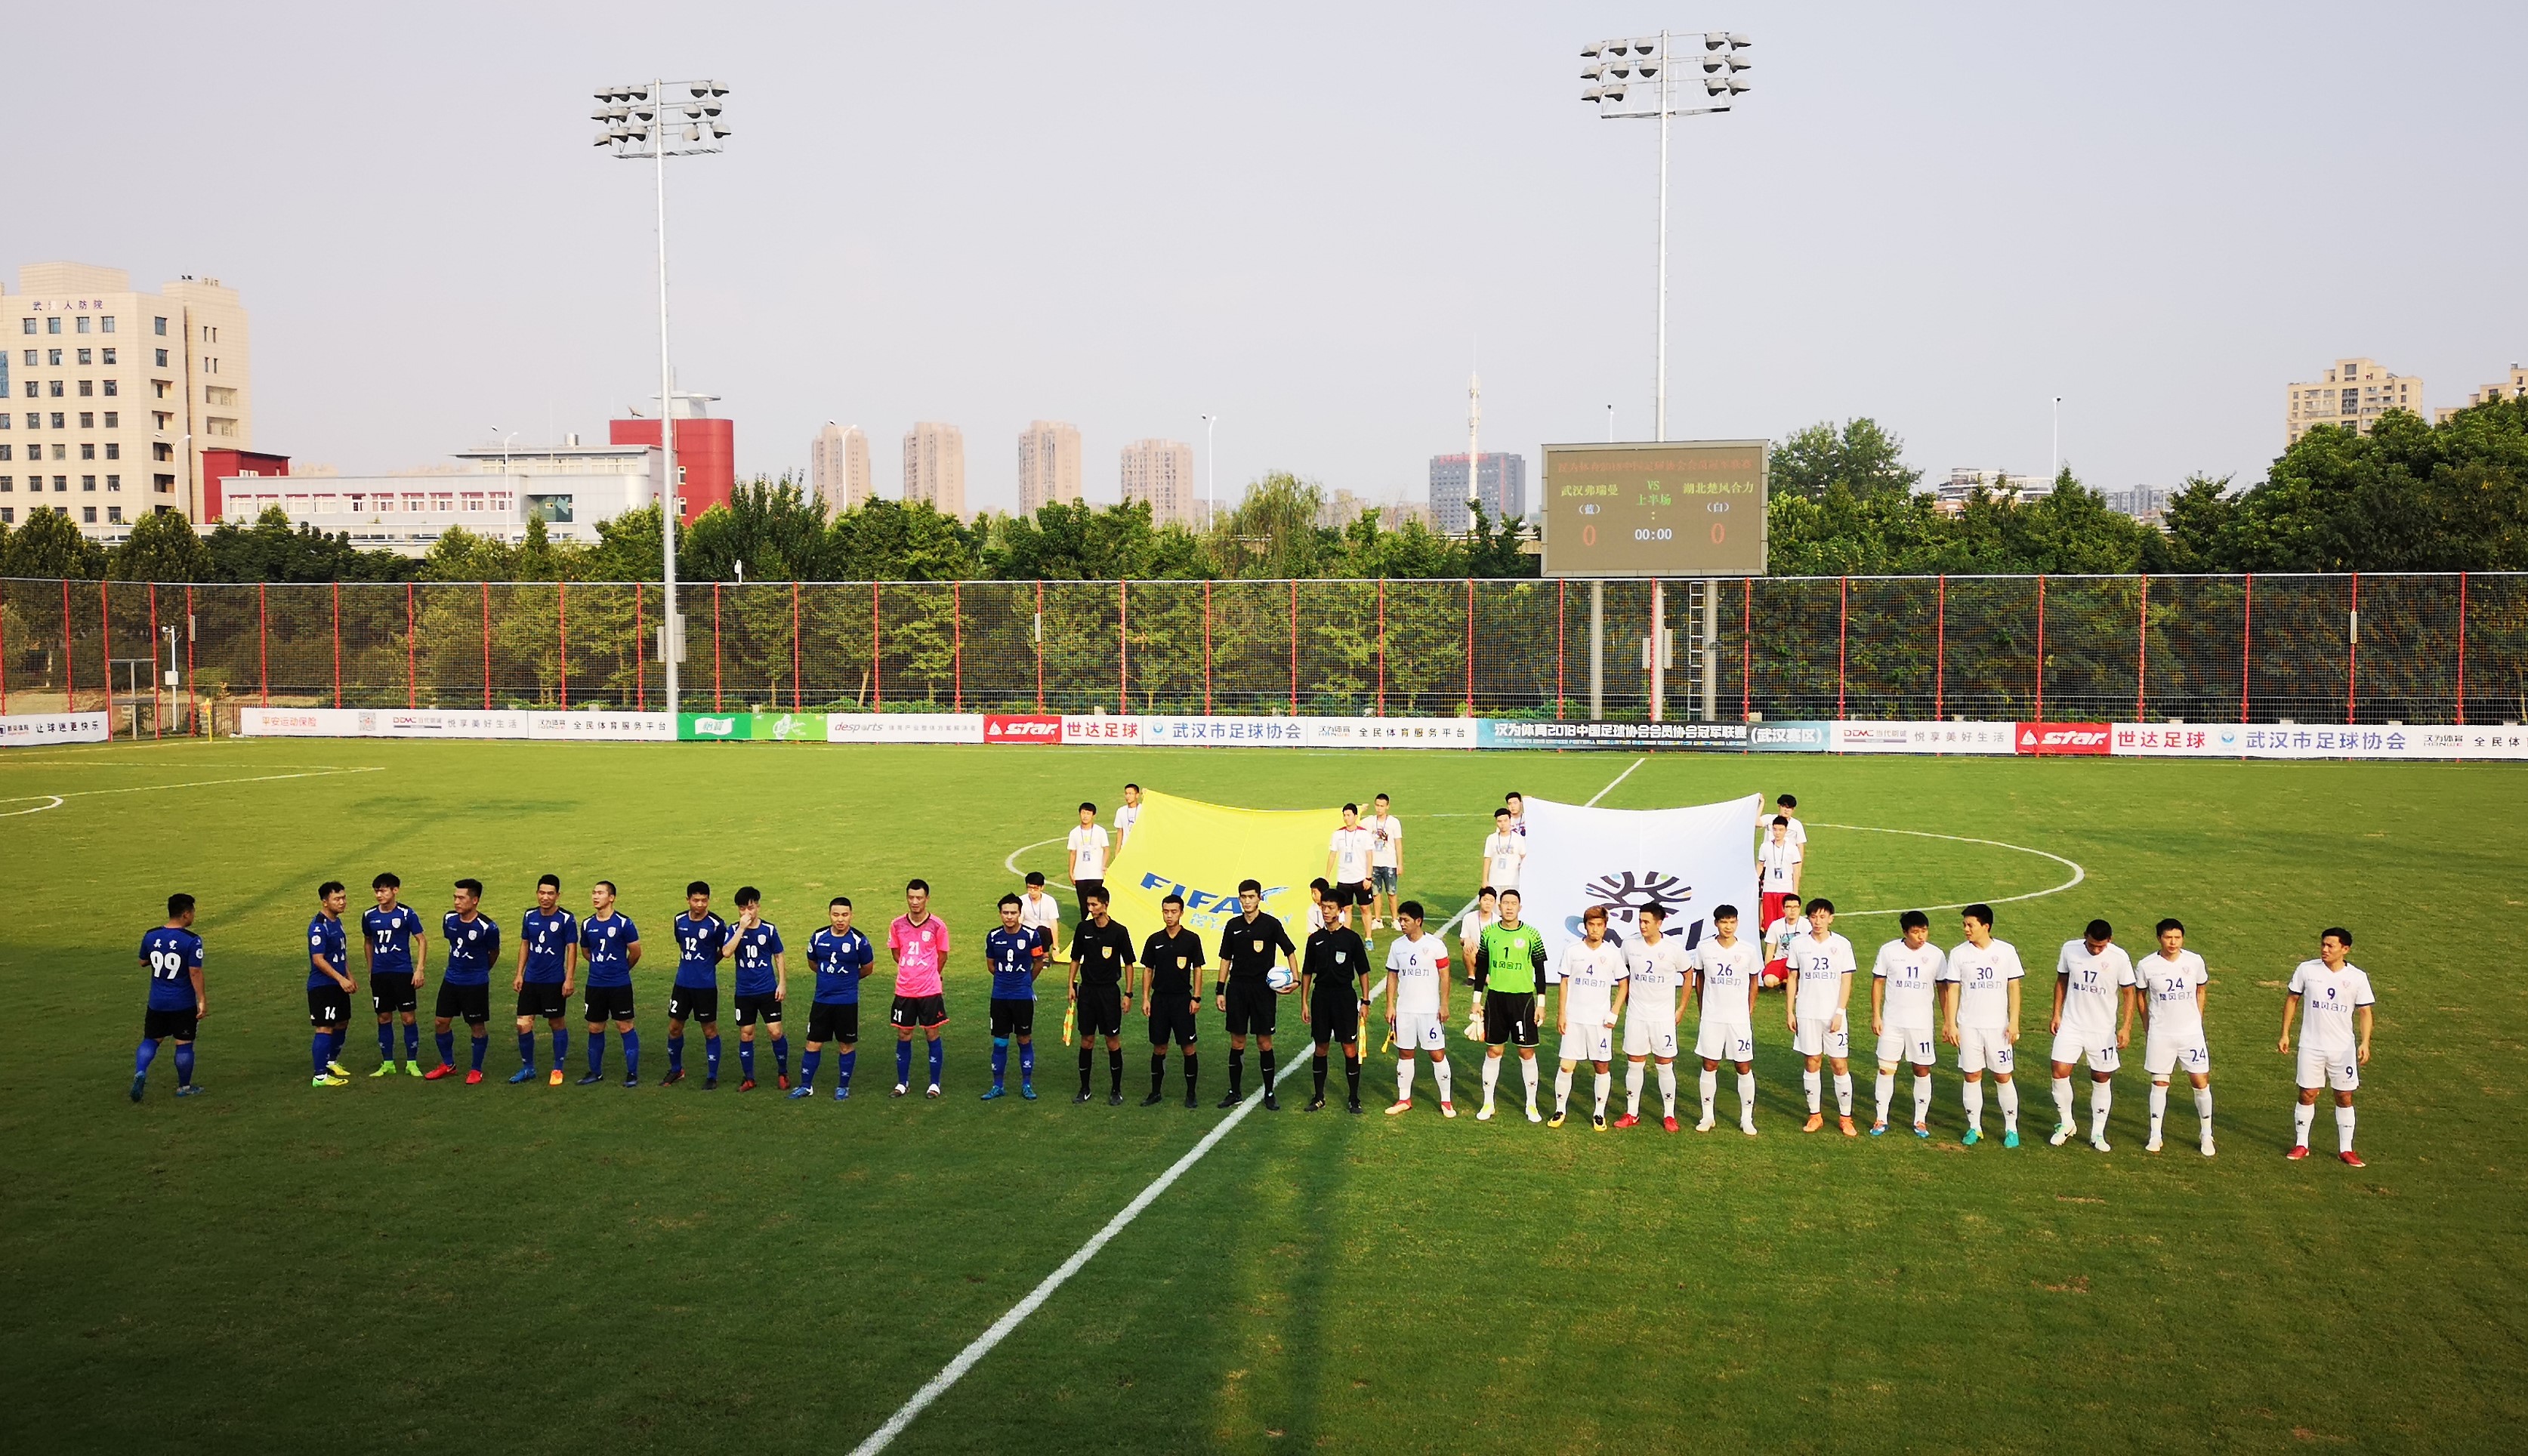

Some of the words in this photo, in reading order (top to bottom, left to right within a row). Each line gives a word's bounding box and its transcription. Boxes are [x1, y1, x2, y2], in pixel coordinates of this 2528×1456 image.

[1561, 484, 1619, 496] 武汉弗瑞曼
[1647, 480, 1660, 490] VS
[1683, 481, 1754, 495] 湖北楚风合力
[1637, 494, 1672, 506] 上半场
[1583, 524, 1596, 546] 0
[1634, 528, 1672, 540] 00:00
[1711, 523, 1725, 544] 0
[262, 717, 316, 726] 平安运动保险
[447, 719, 517, 729] 悦享美好生活
[574, 721, 666, 730] 全民体育服务平台
[1066, 722, 1138, 739] 世达足球
[1172, 722, 1301, 739] 武汉市足球协会
[1359, 727, 1465, 738] 全民体育服务平台
[1915, 731, 2005, 742] 悦享美好生活
[2117, 731, 2205, 748] 世达足球
[2246, 731, 2406, 750] 武汉市足球协会
[2474, 736, 2528, 748] 全民体
[1140, 871, 1244, 915] FIFA
[377, 930, 392, 943] 77
[457, 937, 463, 949] 9
[539, 930, 545, 943] 6
[600, 939, 606, 952] 7
[685, 937, 697, 952] 12
[908, 941, 919, 955] 21
[745, 945, 758, 958] 10
[1007, 949, 1014, 962] 8
[1503, 947, 1509, 959] 1
[150, 951, 181, 979] 99
[1410, 954, 1417, 966] 6
[1812, 957, 1829, 970] 23
[1585, 964, 1593, 975] 4
[1645, 961, 1653, 973] 2
[1717, 963, 1733, 976] 26
[1906, 967, 1918, 979] 11
[1977, 967, 1993, 980] 30
[2083, 970, 2098, 983] 17
[2165, 977, 2184, 992] 24
[2328, 987, 2335, 1000] 9
[373, 996, 379, 1009] 7
[325, 1006, 336, 1020] 14
[893, 1008, 903, 1023] 21
[1429, 1027, 1437, 1039] 6
[1515, 1020, 1523, 1035] 1
[1600, 1038, 1607, 1049] 4
[1665, 1035, 1672, 1047] 2
[1738, 1039, 1751, 1051] 26
[1919, 1041, 1930, 1054] 11
[1998, 1049, 2011, 1063] 30
[2101, 1047, 2113, 1061] 17
[2190, 1047, 2205, 1063] 24
[2346, 1066, 2354, 1079] 9
